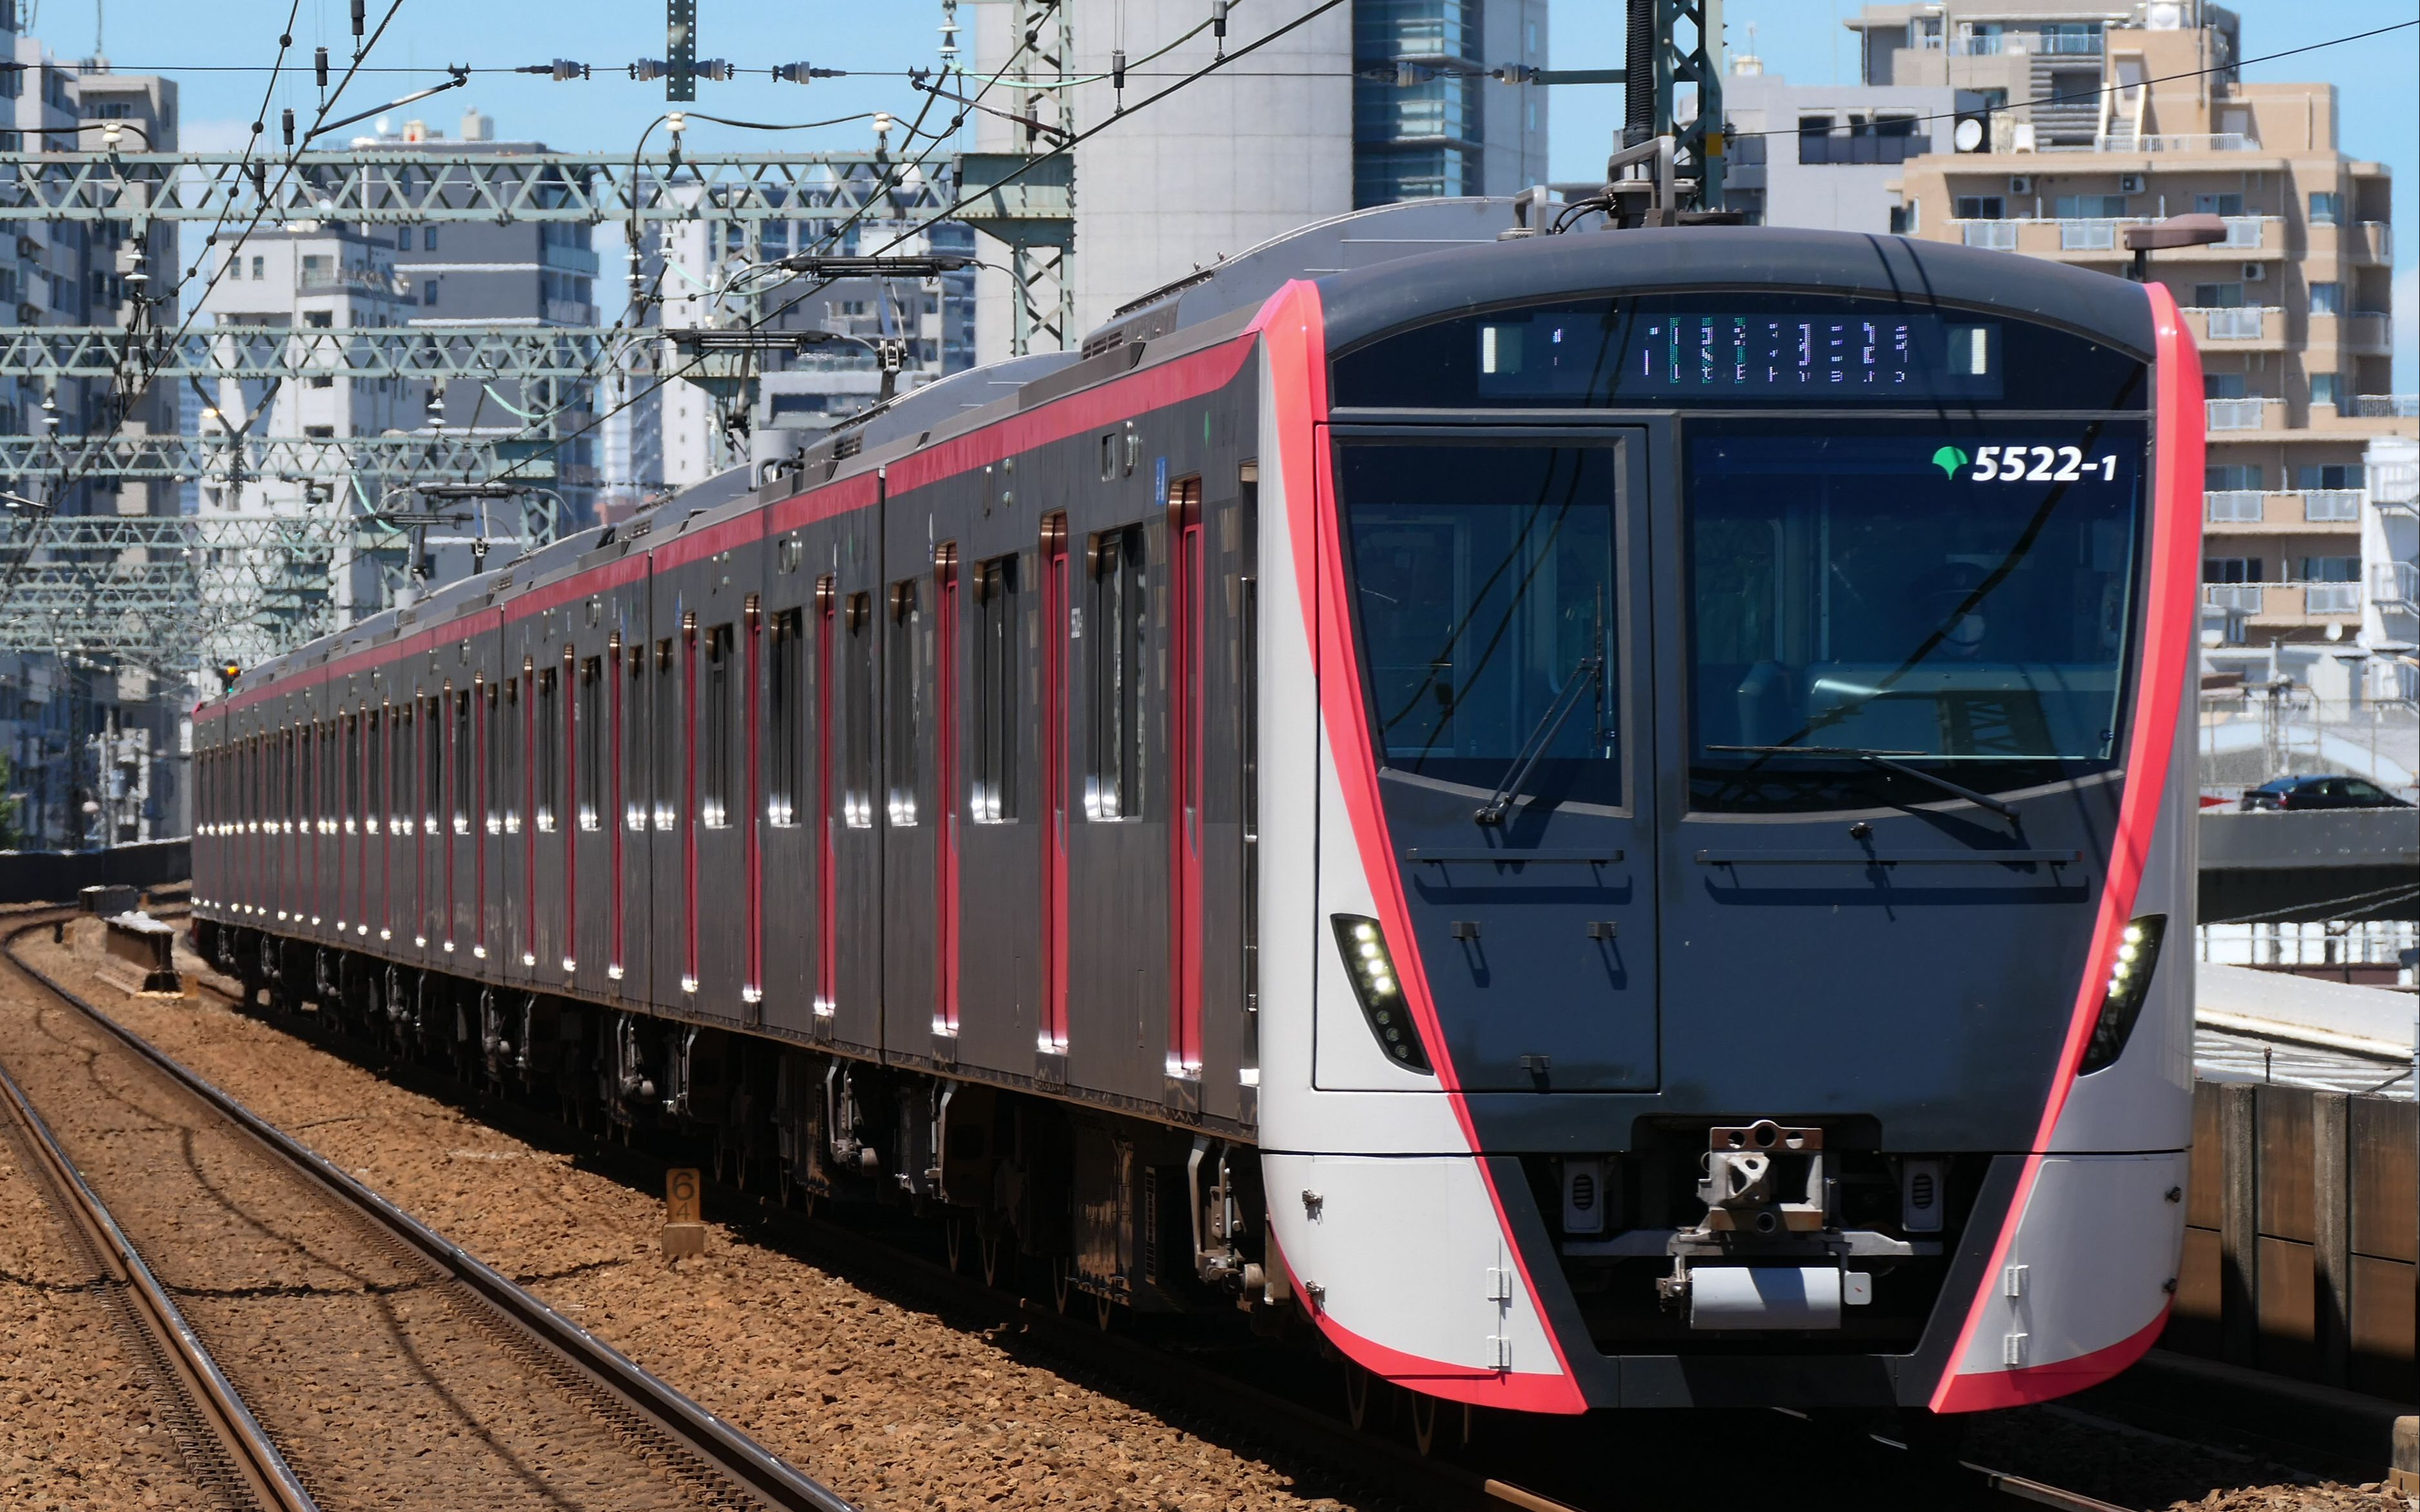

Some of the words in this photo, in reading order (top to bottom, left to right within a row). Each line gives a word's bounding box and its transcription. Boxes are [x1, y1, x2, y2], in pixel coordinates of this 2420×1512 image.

[1972, 446, 2117, 481] 5522-1
[673, 1172, 694, 1201] 6
[677, 1202, 691, 1221] 4
